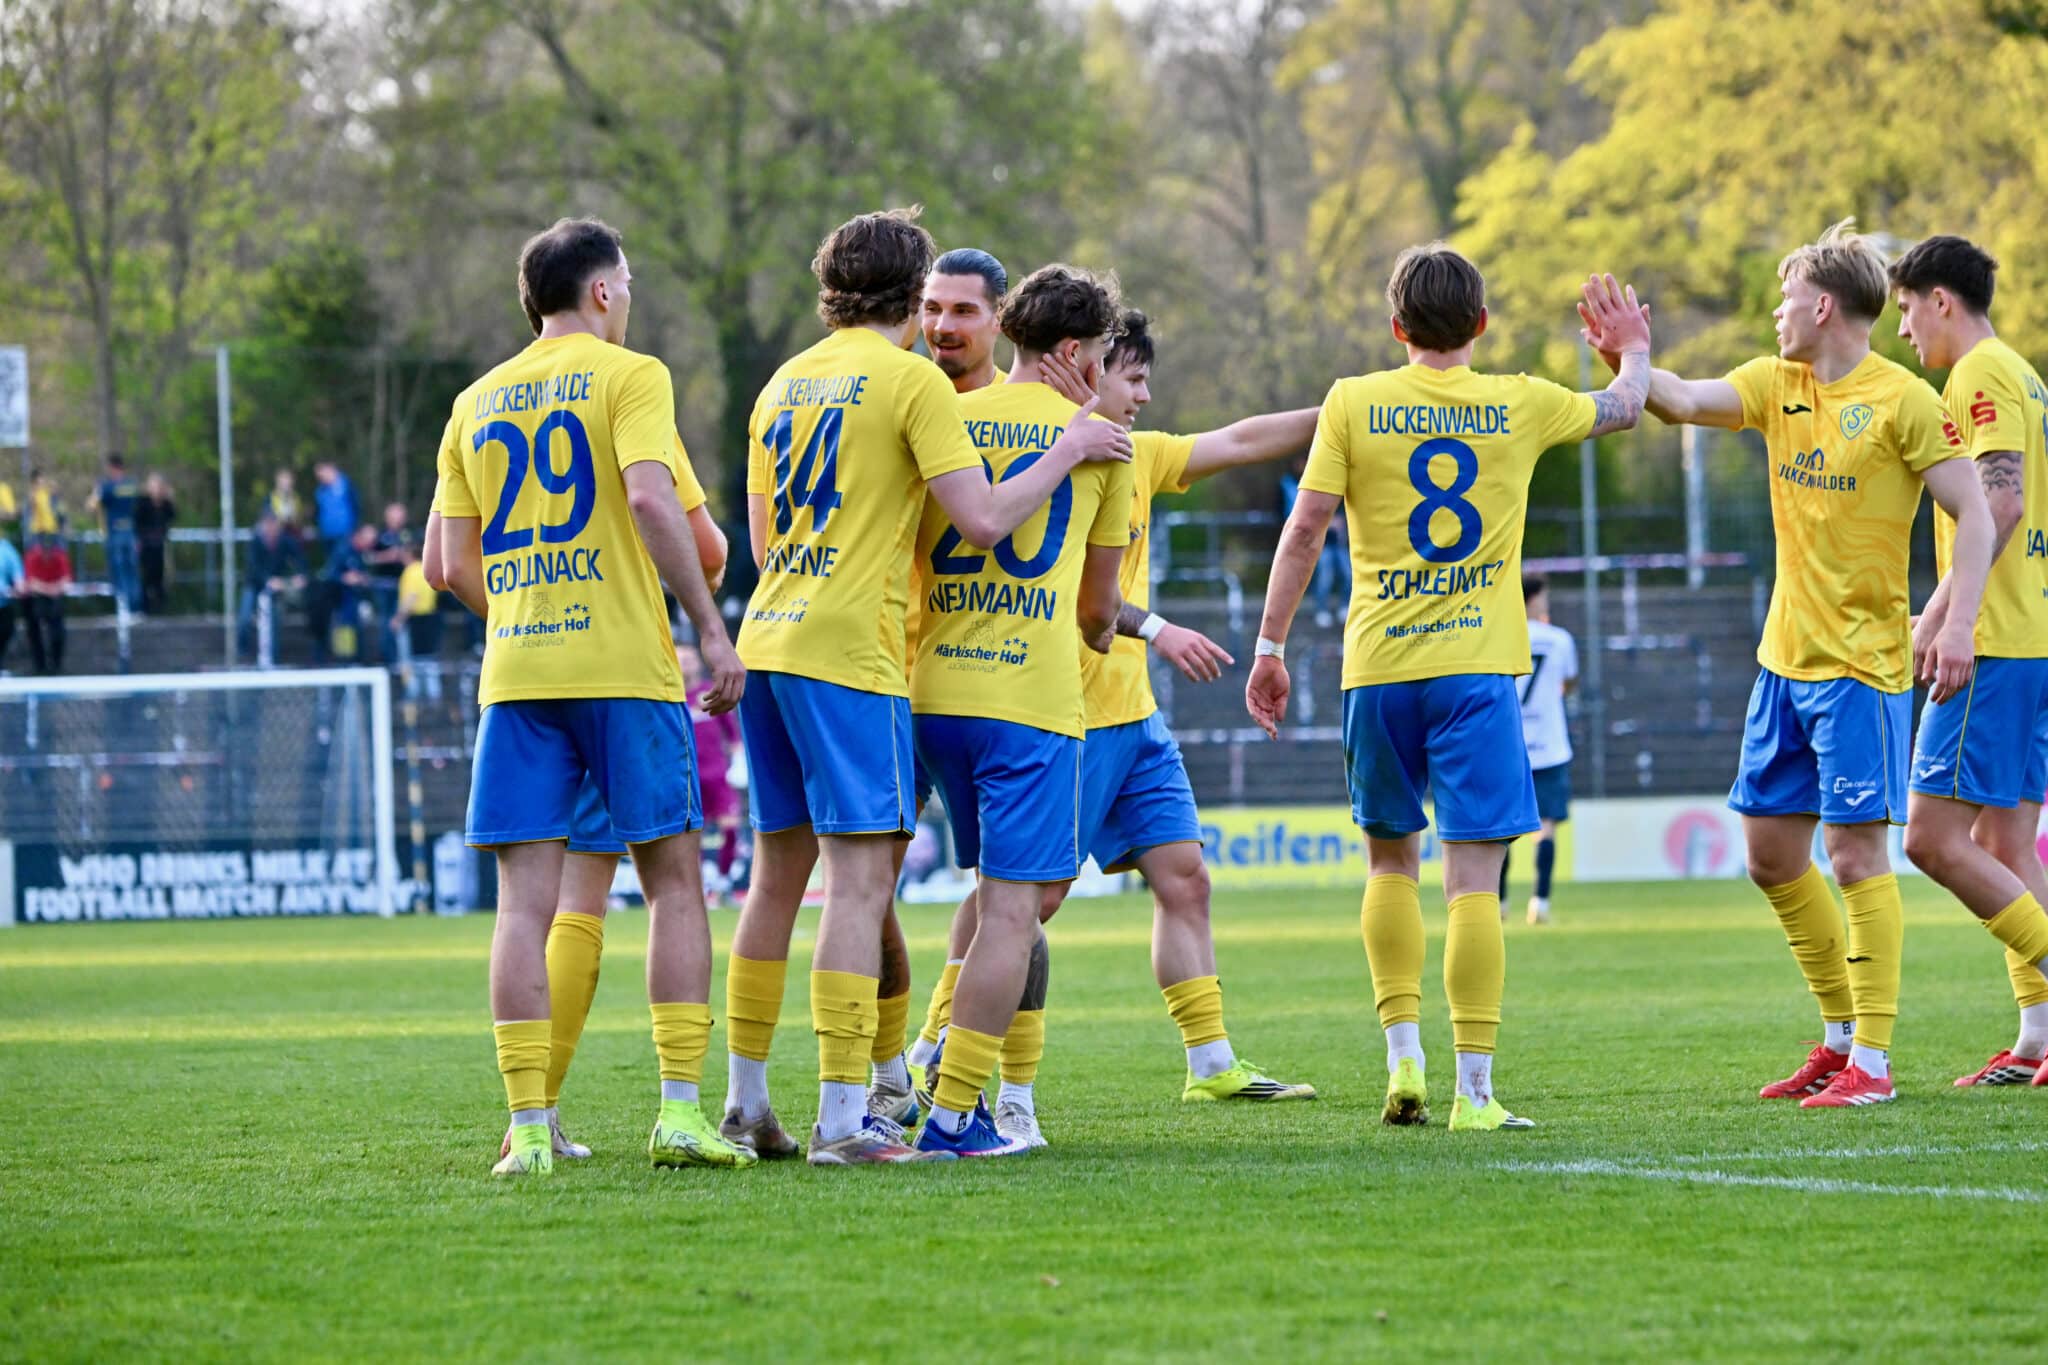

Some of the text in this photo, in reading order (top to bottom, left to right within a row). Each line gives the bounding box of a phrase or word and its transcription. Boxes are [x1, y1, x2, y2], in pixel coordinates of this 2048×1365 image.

[475, 371, 593, 420] LUCKENWALDE
[768, 376, 869, 409] CKENWALDE
[963, 420, 1065, 450] KENWALD
[1369, 405, 1510, 434] LUCKENWALDE
[473, 409, 597, 556] 29
[762, 408, 843, 535] 14
[1408, 437, 1482, 563] 8
[486, 548, 603, 595] GOLLNACK
[928, 581, 1056, 621] NEUMANN
[564, 616, 591, 632] Hof
[1385, 616, 1483, 638] Märkischer Hof
[934, 643, 1028, 665] Märkischer Hof
[58, 849, 373, 888] WHO DRINKS MILK AT
[24, 887, 169, 921] FOOTBALL
[172, 885, 276, 918] MATCH
